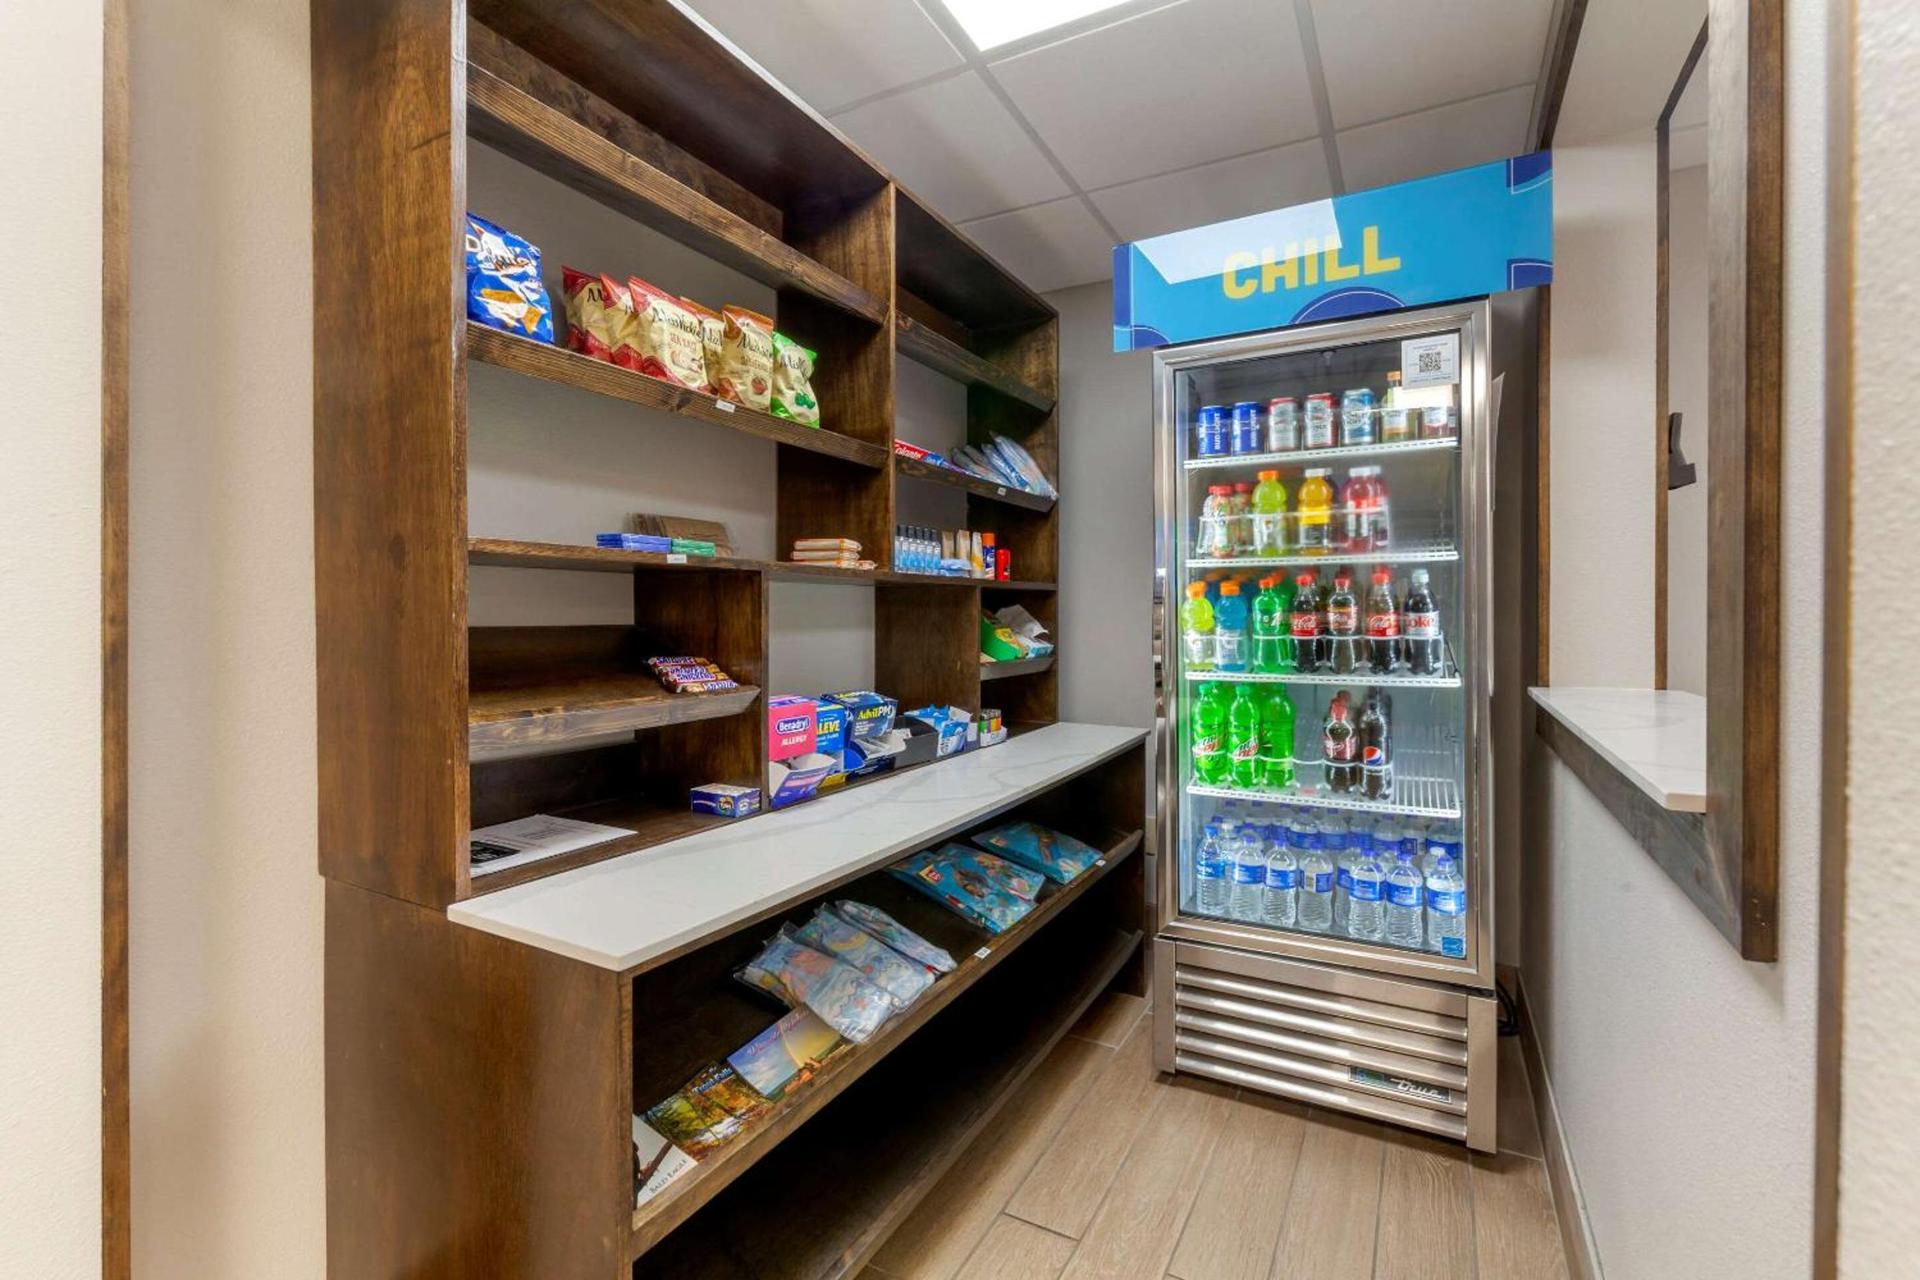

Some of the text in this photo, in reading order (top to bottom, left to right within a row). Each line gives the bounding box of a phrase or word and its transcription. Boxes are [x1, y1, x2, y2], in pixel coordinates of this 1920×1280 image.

[1222, 225, 1401, 299] CHILL
[859, 705, 892, 720] Advil PM
[779, 718, 809, 732] Benadryl
[816, 720, 840, 735] LEVE
[782, 735, 808, 746] ALLERGY
